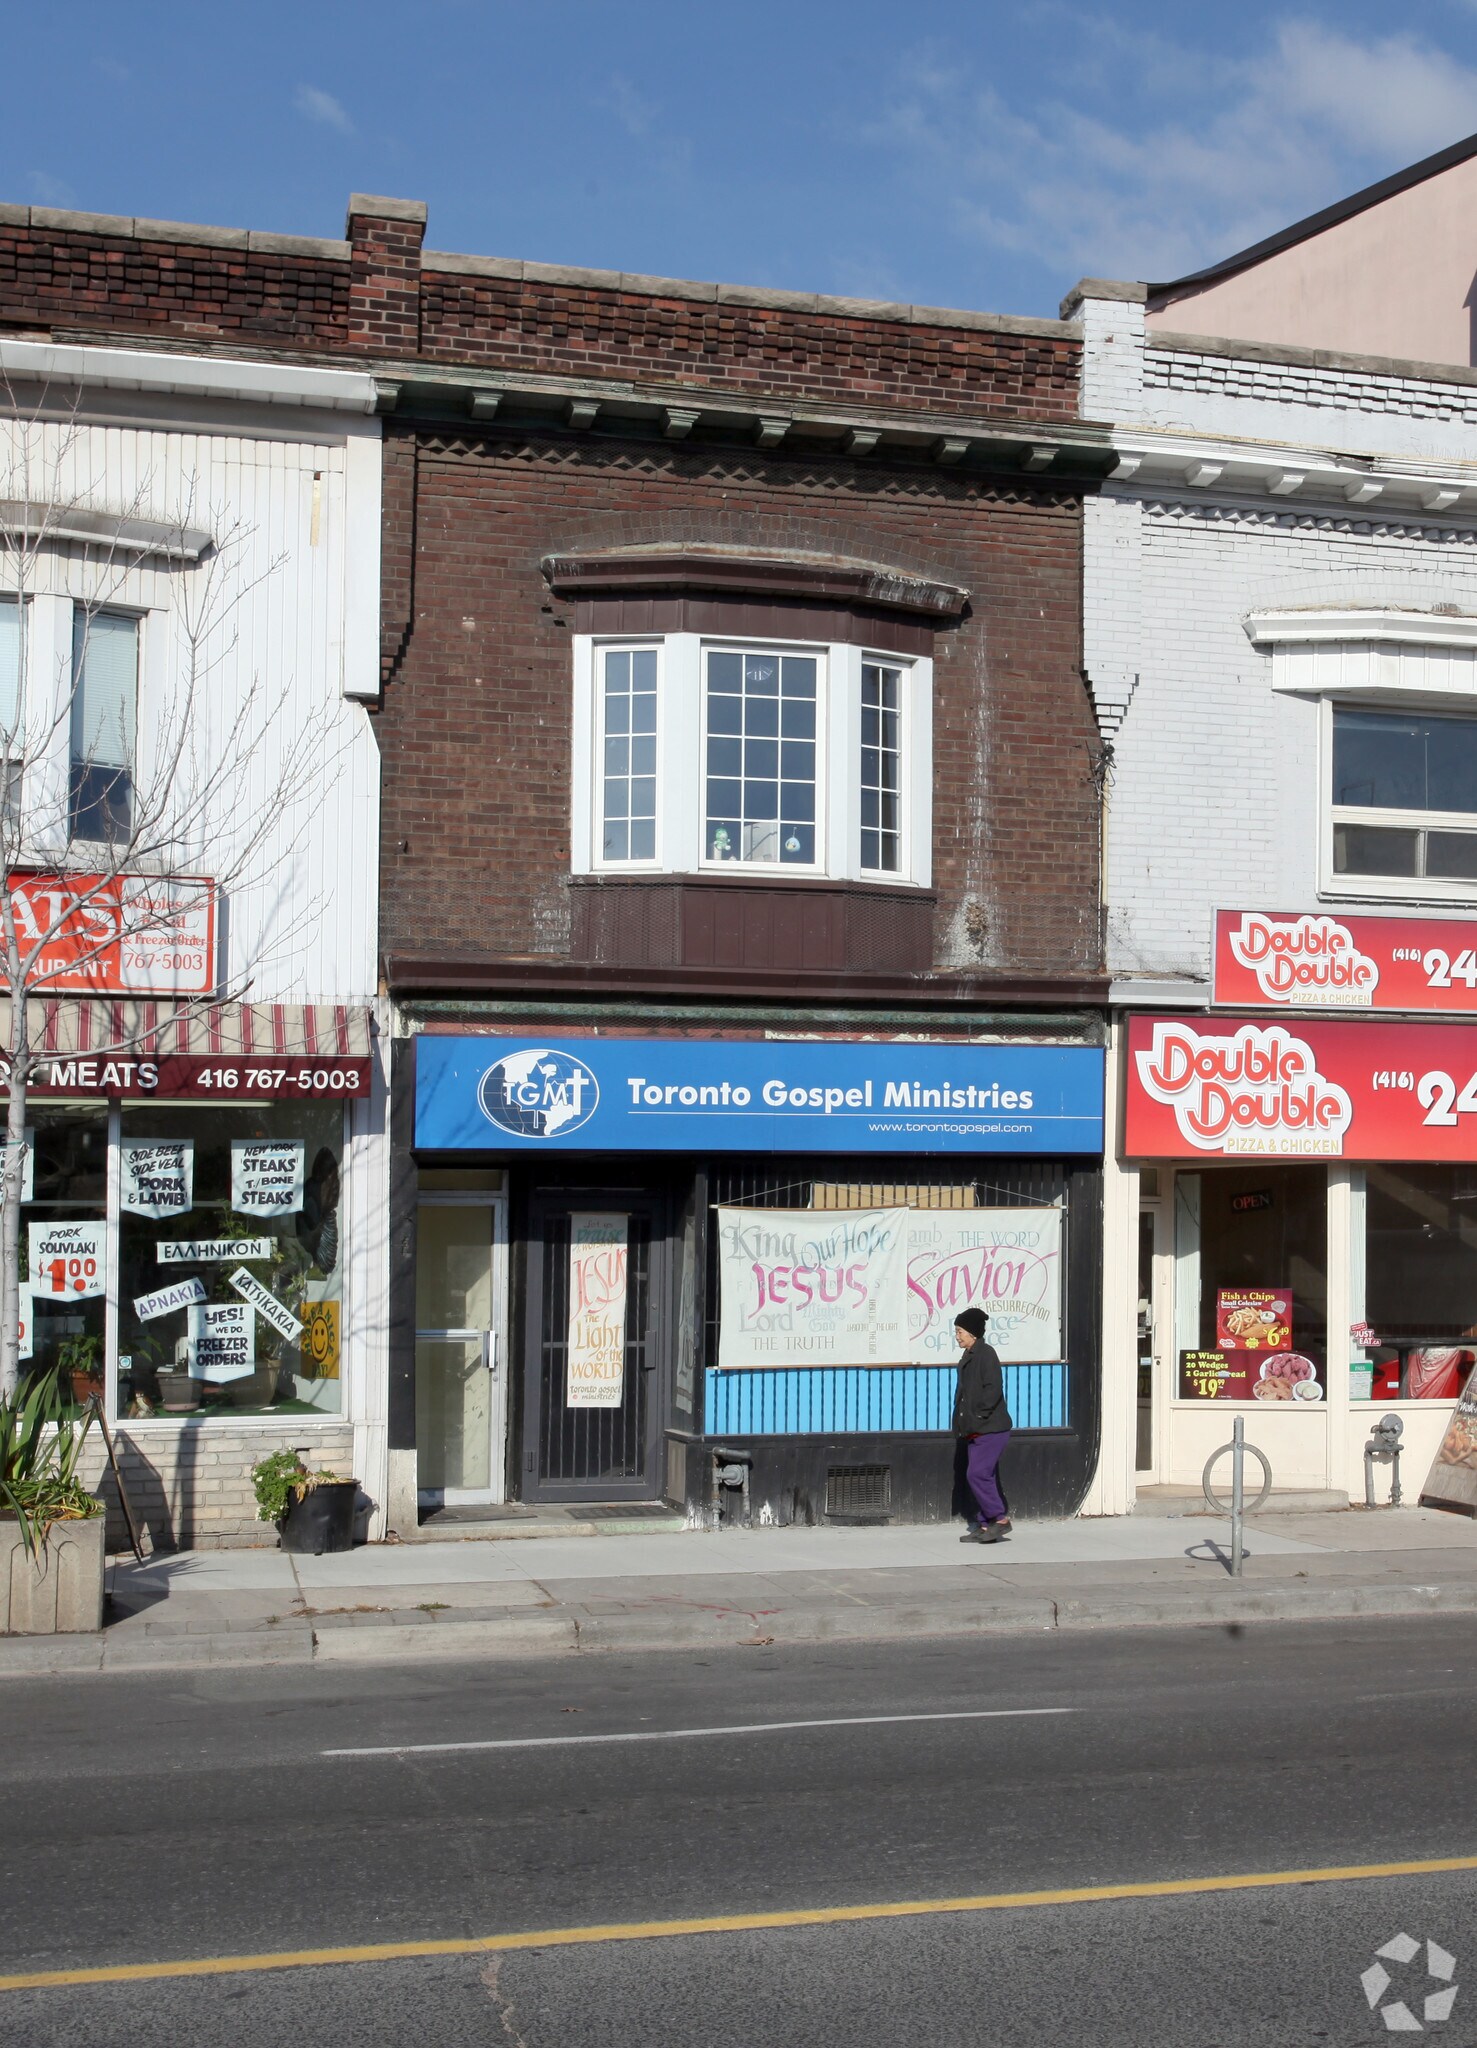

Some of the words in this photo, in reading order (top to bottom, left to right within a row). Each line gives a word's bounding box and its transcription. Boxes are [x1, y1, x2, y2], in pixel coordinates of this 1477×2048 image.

[127, 897, 205, 910] Wholese
[1239, 922, 1345, 960] Double
[124, 953, 203, 970] 767-5003
[1392, 948, 1421, 962] (416)
[1265, 954, 1371, 992] Double
[1292, 993, 1319, 1003] PIZZA
[1321, 994, 1327, 1003] &
[1329, 994, 1370, 1005] CHICKEN
[1149, 1035, 1306, 1092] Double
[50, 1062, 159, 1088] MEATS
[197, 1069, 238, 1089] 416
[246, 1069, 360, 1090] 767-5003
[1373, 1071, 1414, 1091] (416)
[627, 1078, 751, 1106] Toronto
[762, 1080, 872, 1113] Gospel
[883, 1081, 1033, 1109] Ministries
[1187, 1081, 1342, 1138] Double
[868, 1122, 1033, 1134] www.torontogospel.com
[129, 1150, 153, 1163] SIDE
[156, 1144, 185, 1157] BEEF
[244, 1147, 269, 1157] NEW
[269, 1143, 297, 1152] YORK
[1227, 1138, 1265, 1152] PIZZA
[1268, 1139, 1277, 1152] &
[1280, 1139, 1339, 1154] CHICKEN
[130, 1162, 154, 1177] SIDE
[158, 1158, 184, 1170] VEAL
[138, 1177, 185, 1192] PORK
[242, 1191, 293, 1205] STEAKS
[1233, 1194, 1269, 1210] OPEN
[49, 1227, 83, 1240] PORK
[832, 1212, 896, 1261] Hope
[908, 1222, 942, 1243] amb
[957, 1231, 985, 1247] THE
[991, 1231, 1040, 1247] WORD
[721, 1216, 799, 1268] King
[920, 1270, 938, 1287] LIFE
[748, 1262, 869, 1320] JESUS
[907, 1246, 1058, 1341] Savior
[1221, 1292, 1240, 1300] Fish
[1250, 1292, 1275, 1302] Chips
[205, 1307, 244, 1325] YES!
[738, 1303, 793, 1333] Lord
[986, 1300, 1051, 1322] RESURRECTION
[196, 1338, 248, 1351] FREEZER
[575, 1313, 623, 1358] Light
[752, 1336, 778, 1350] THE
[784, 1335, 835, 1350] TRUTH
[924, 1331, 948, 1352] of
[196, 1352, 246, 1366] ORDERS
[596, 1350, 608, 1361] of
[1198, 1352, 1224, 1361] Wings
[571, 1361, 623, 1379] WORLD
[1198, 1361, 1228, 1370] Wedges
